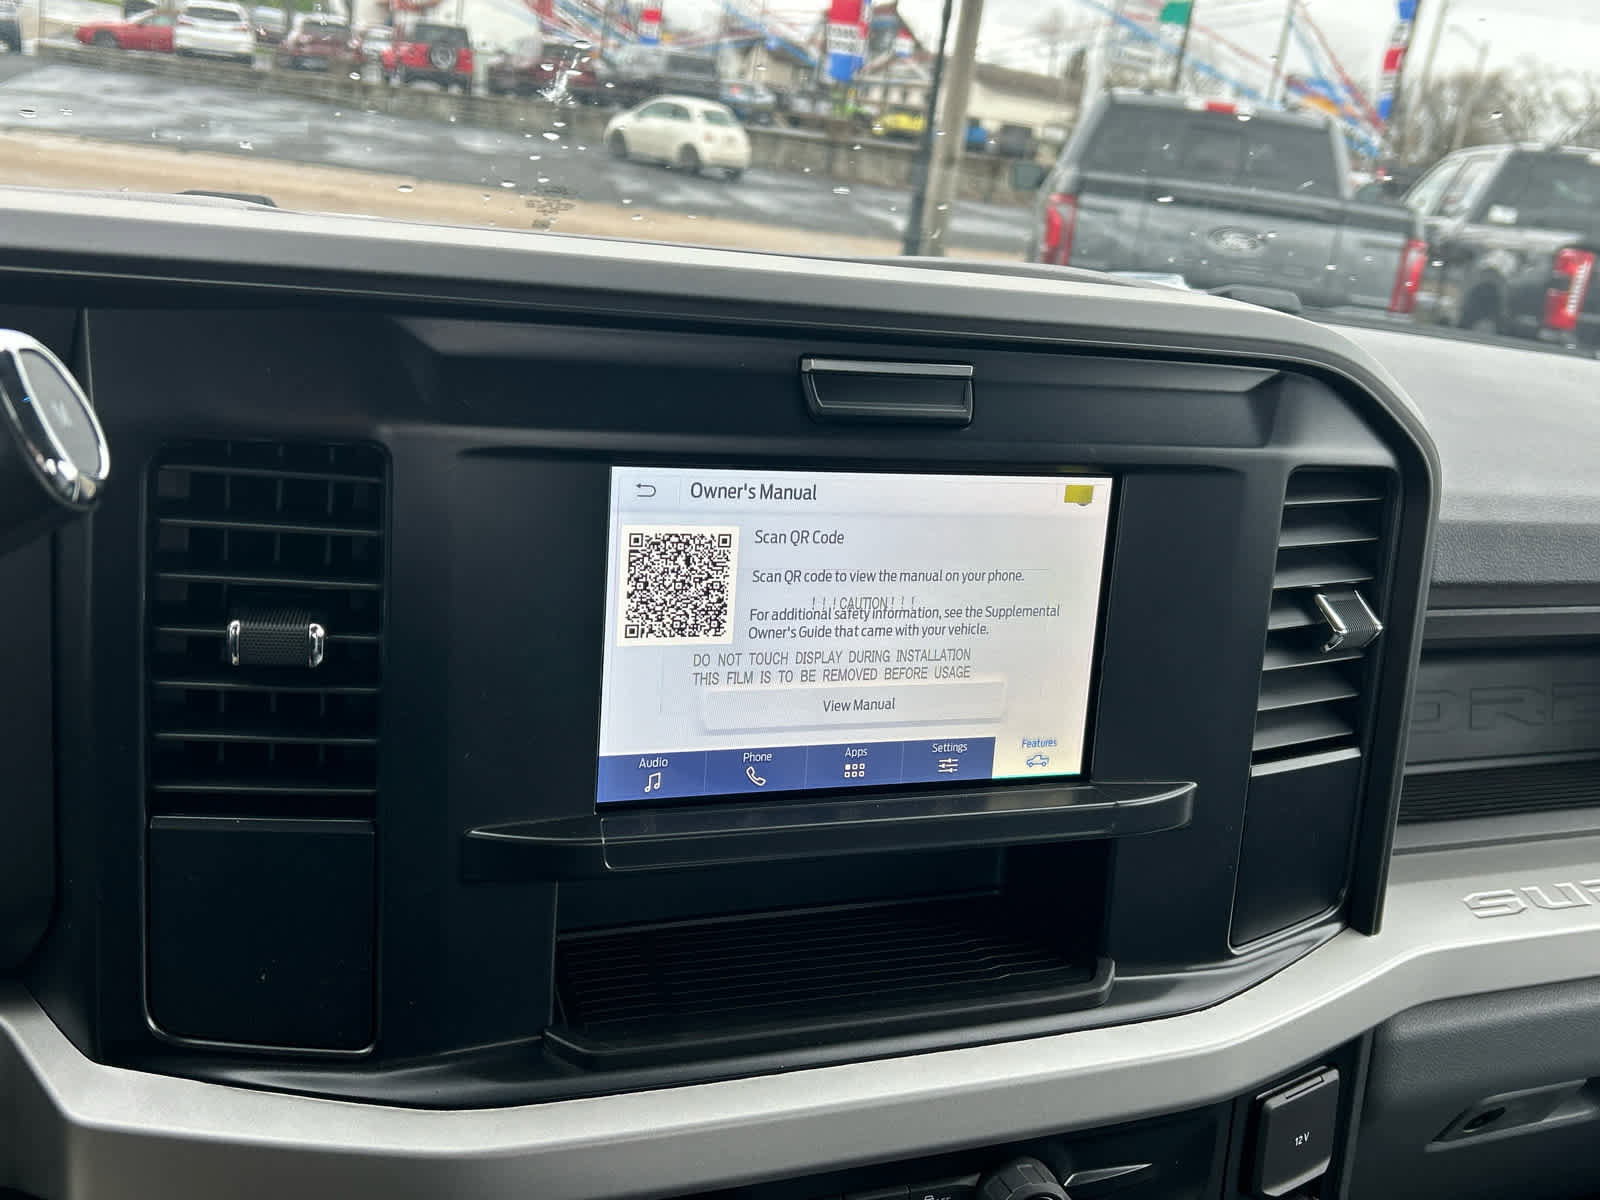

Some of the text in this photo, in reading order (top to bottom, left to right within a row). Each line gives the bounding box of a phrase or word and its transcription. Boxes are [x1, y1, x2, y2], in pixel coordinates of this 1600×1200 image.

[690, 481, 817, 500] Owner's Manual
[754, 529, 845, 546] Scan QR Code
[752, 568, 1025, 585] Scan QR code to view the manual on your phone.
[750, 604, 1060, 622] For additional safety information, see the Supplemental
[748, 623, 989, 639] Owner's Guide that came with your vehicle.
[693, 648, 971, 667] DO NOT TOUCH DISPLAY DURING INSTALLATION
[693, 665, 971, 686] THIS FILM IS TO BE REMOVED BEFORE USAGE
[823, 697, 896, 712] View Manual
[931, 742, 968, 754] Settings
[1021, 736, 1058, 749] Features
[742, 751, 773, 763] Phone
[844, 747, 868, 759] Apps
[638, 756, 669, 769] Audio
